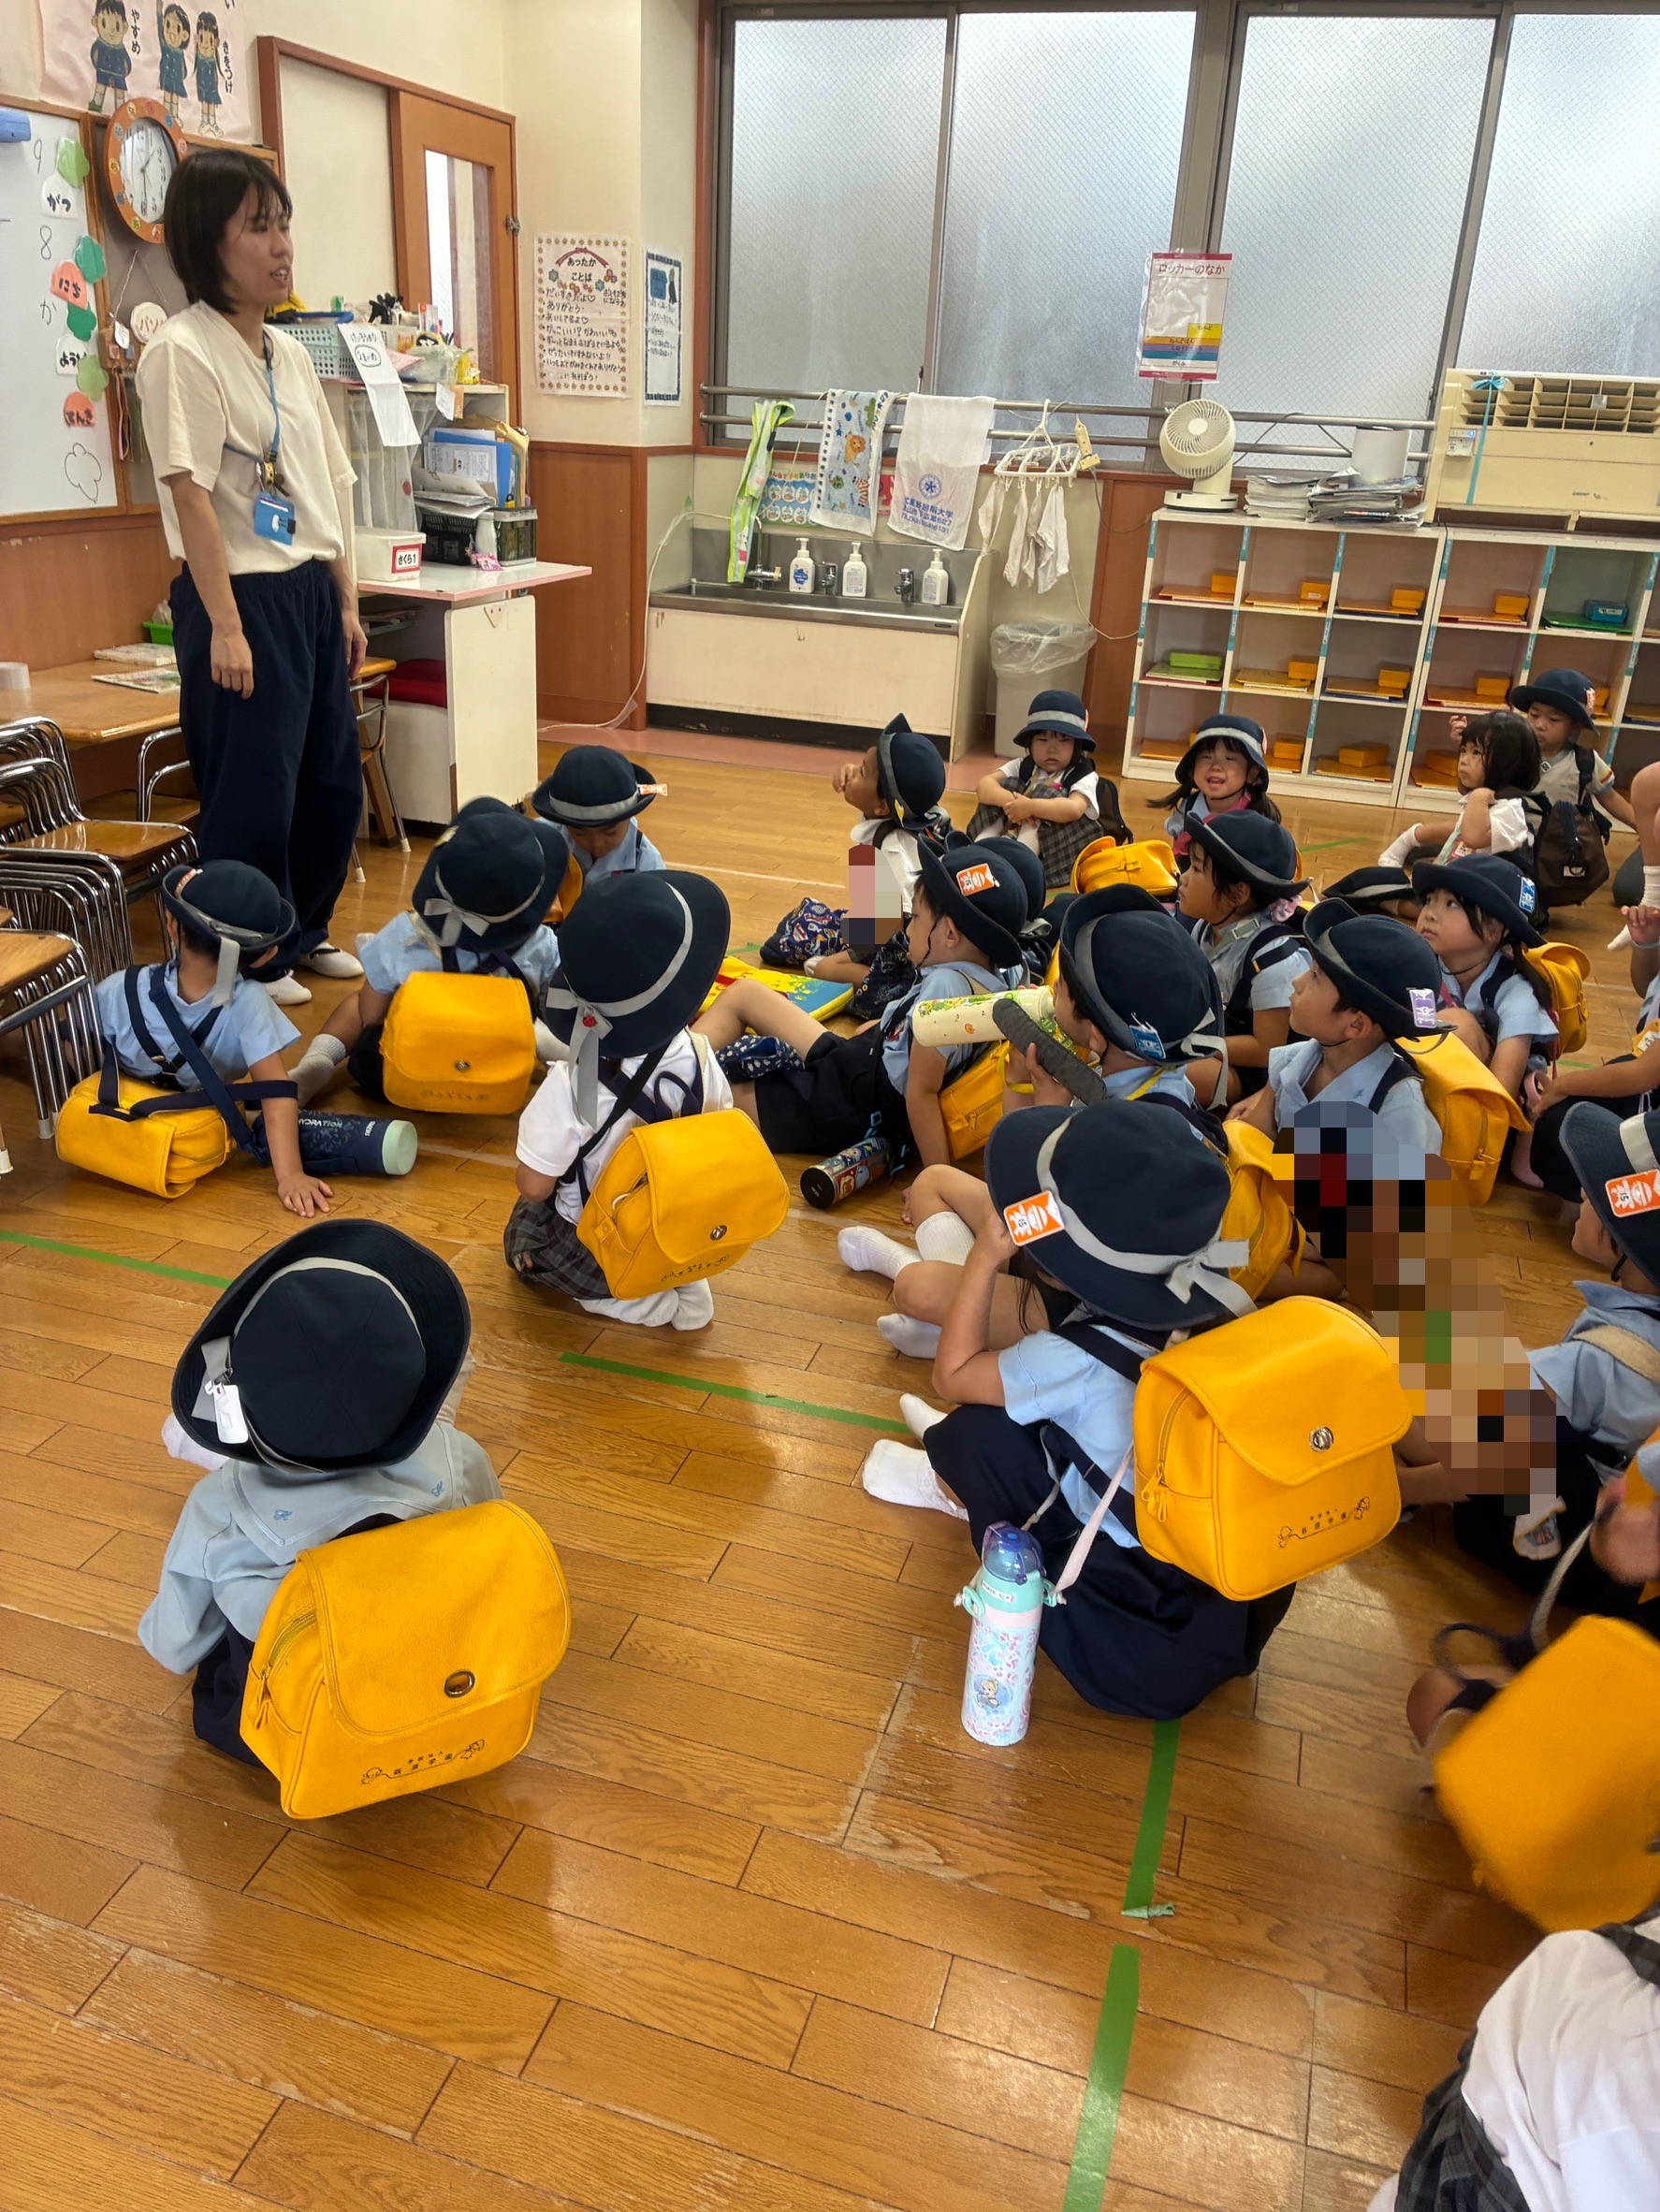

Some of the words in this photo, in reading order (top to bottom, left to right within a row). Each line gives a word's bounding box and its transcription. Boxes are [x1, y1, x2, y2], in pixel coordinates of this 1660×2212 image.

[131, 8, 141, 55] やすめ
[222, 40, 234, 95] きをつけ
[34, 138, 43, 175] 9
[47, 192, 72, 213] がつ
[39, 225, 52, 261] 8
[567, 256, 597, 268] あったか
[1158, 263, 1226, 276] ロッカーのなか
[58, 278, 81, 299] にち
[40, 299, 58, 326] か
[398, 553, 416, 565] さくら1
